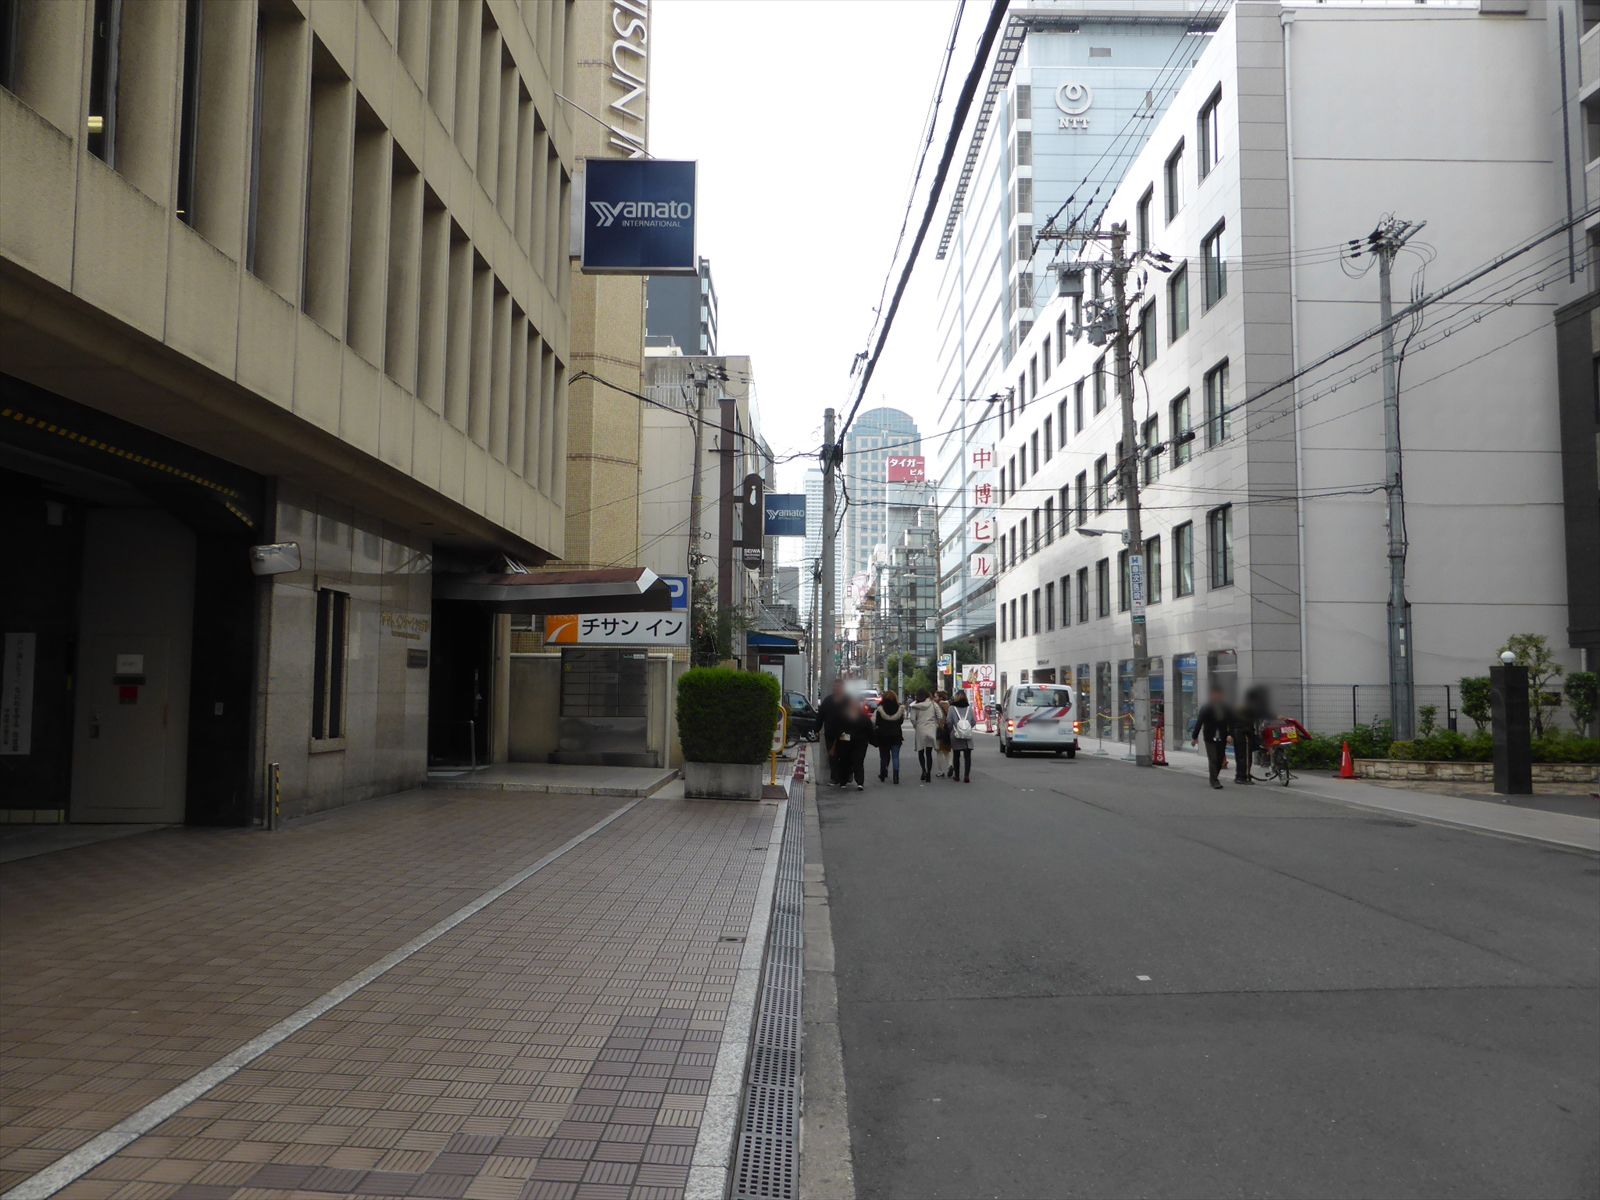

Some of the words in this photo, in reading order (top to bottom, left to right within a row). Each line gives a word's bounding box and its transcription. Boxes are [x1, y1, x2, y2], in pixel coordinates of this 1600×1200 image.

[610, 0, 647, 121] ISUN
[1058, 117, 1089, 128] NTT
[889, 458, 924, 468] タイガー
[582, 617, 639, 636] チサン
[646, 618, 683, 637] イン
